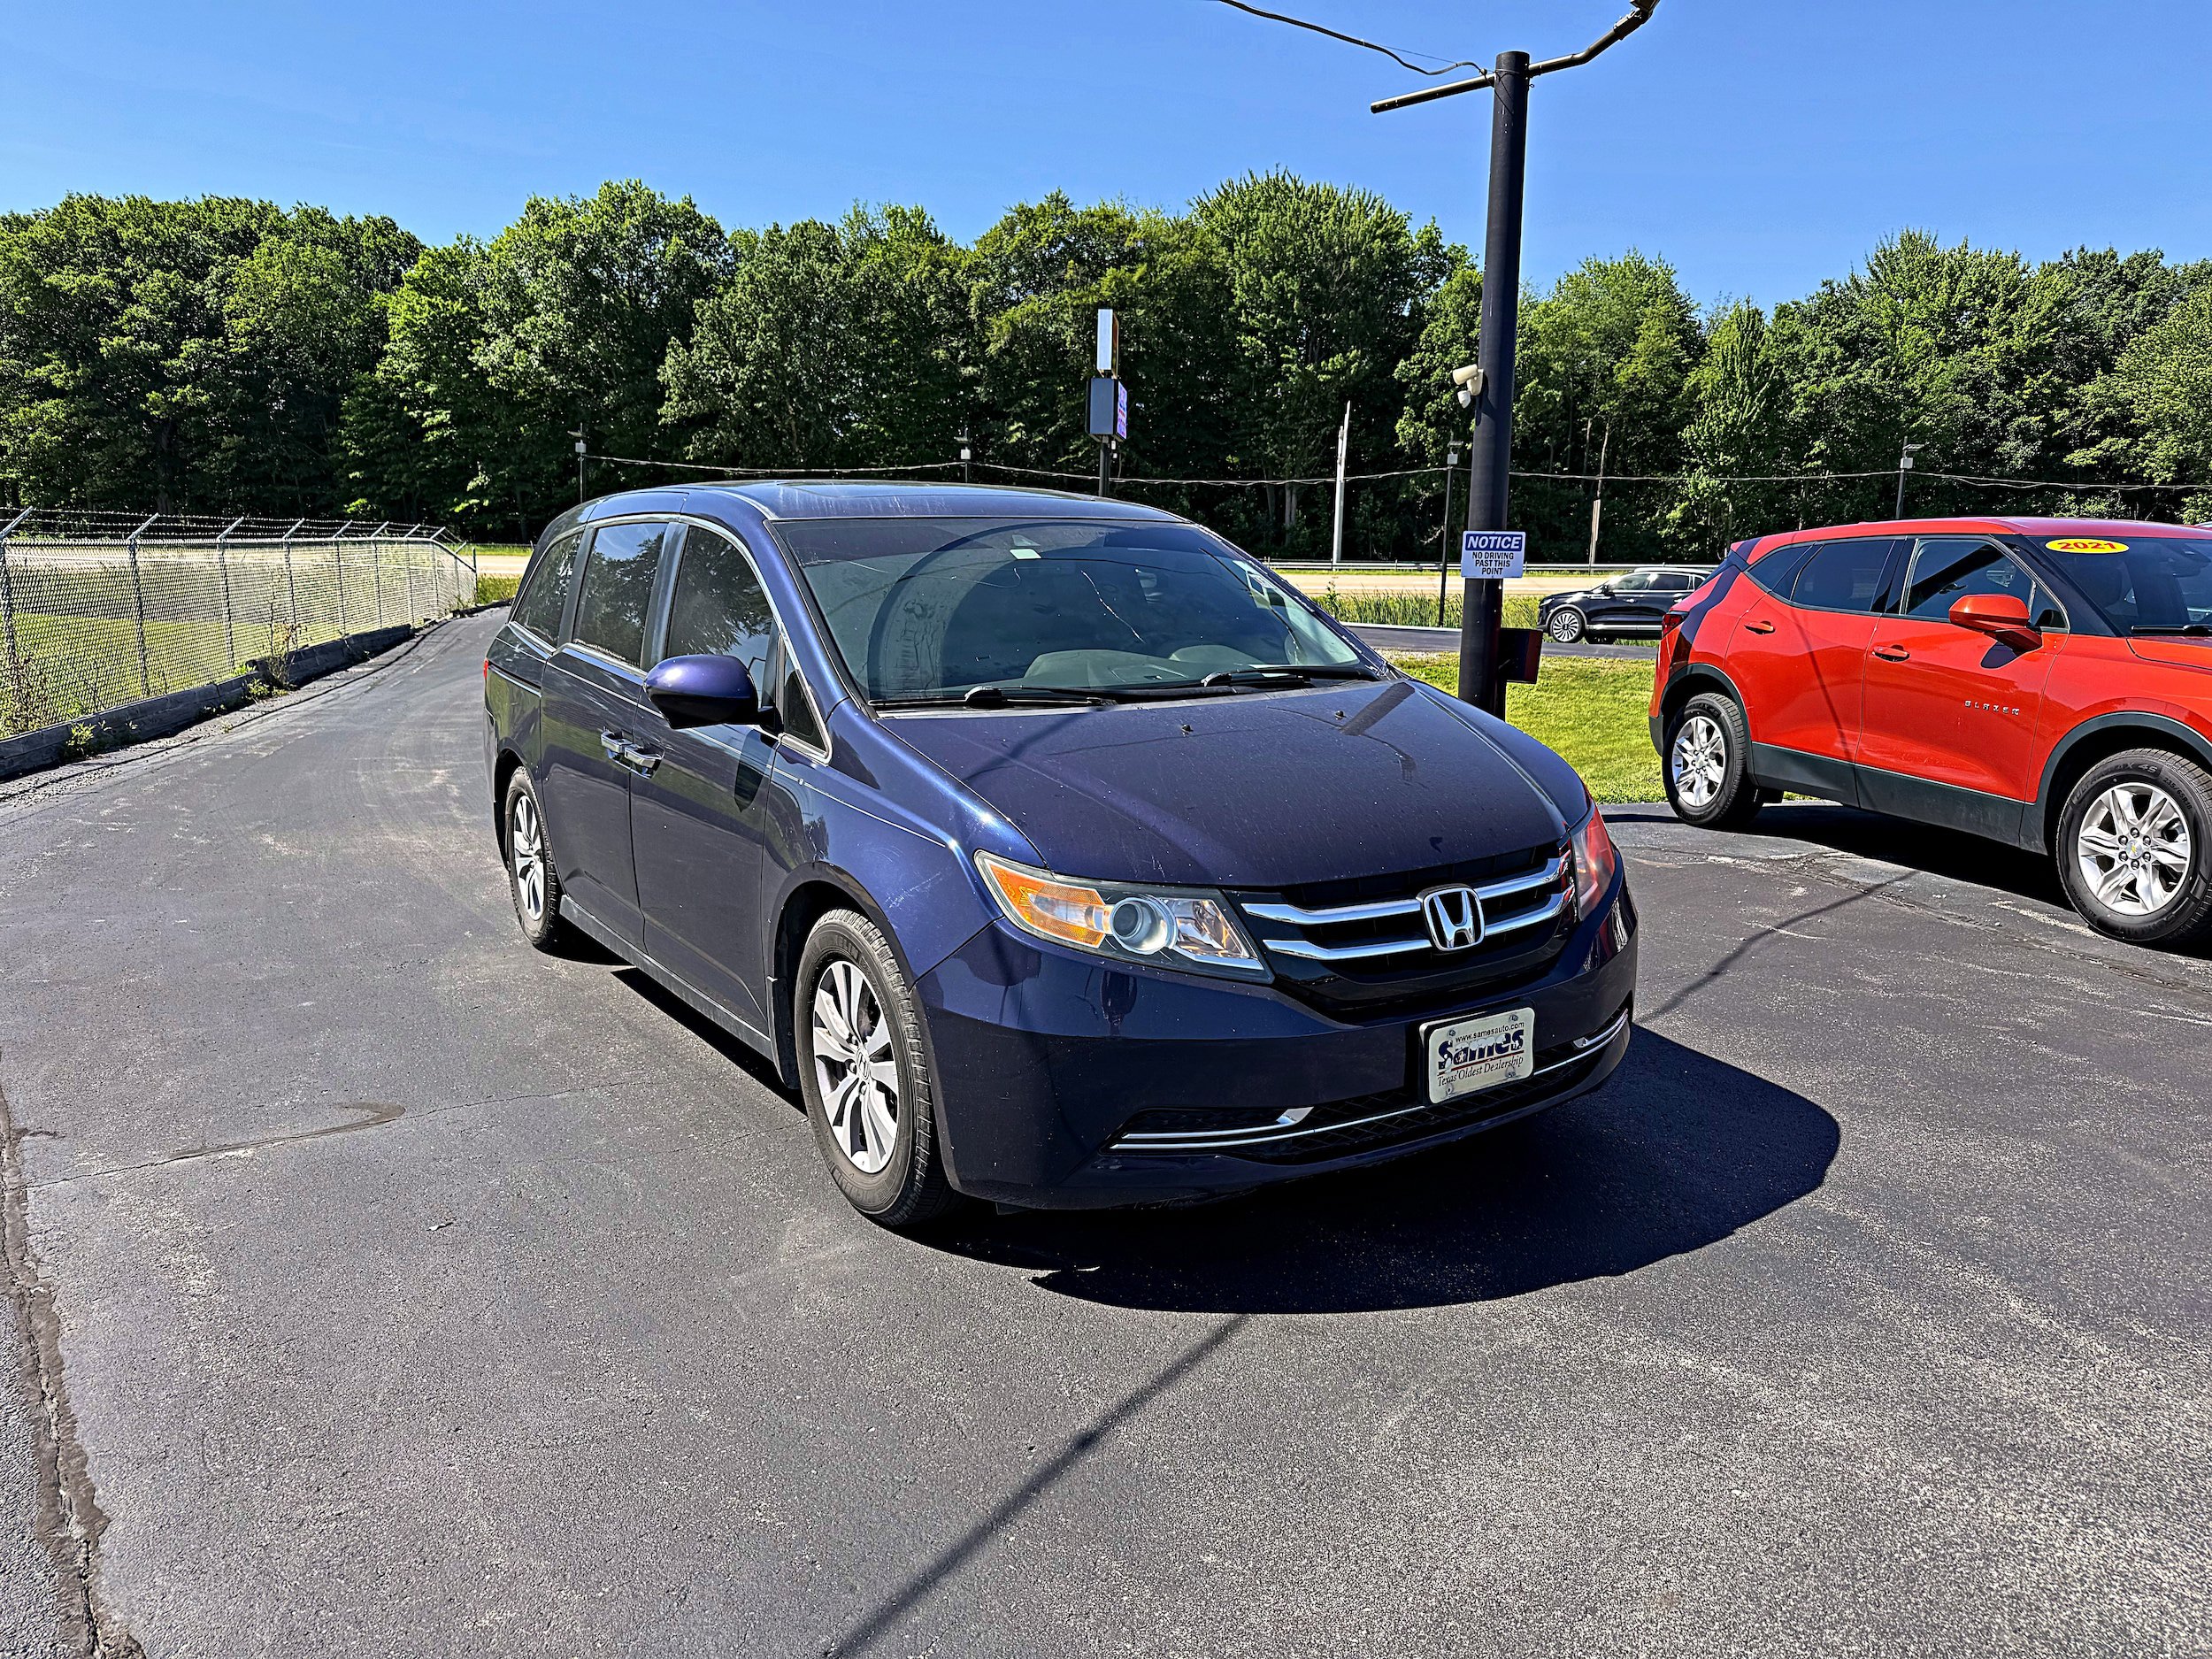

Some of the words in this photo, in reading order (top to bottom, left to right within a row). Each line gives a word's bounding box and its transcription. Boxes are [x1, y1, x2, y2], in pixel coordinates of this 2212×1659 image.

[1468, 535, 1521, 549] NOTICE
[2057, 541, 2117, 550] 2021
[1472, 551, 1483, 560] NO
[1484, 551, 1514, 560] DRIVING
[1964, 700, 2020, 716] BLAZER
[1455, 1021, 1525, 1043] www.samesauto.com
[1438, 1029, 1525, 1071] Sames
[1458, 1065, 1482, 1080] Oldest
[1483, 1055, 1524, 1074] Dealership
